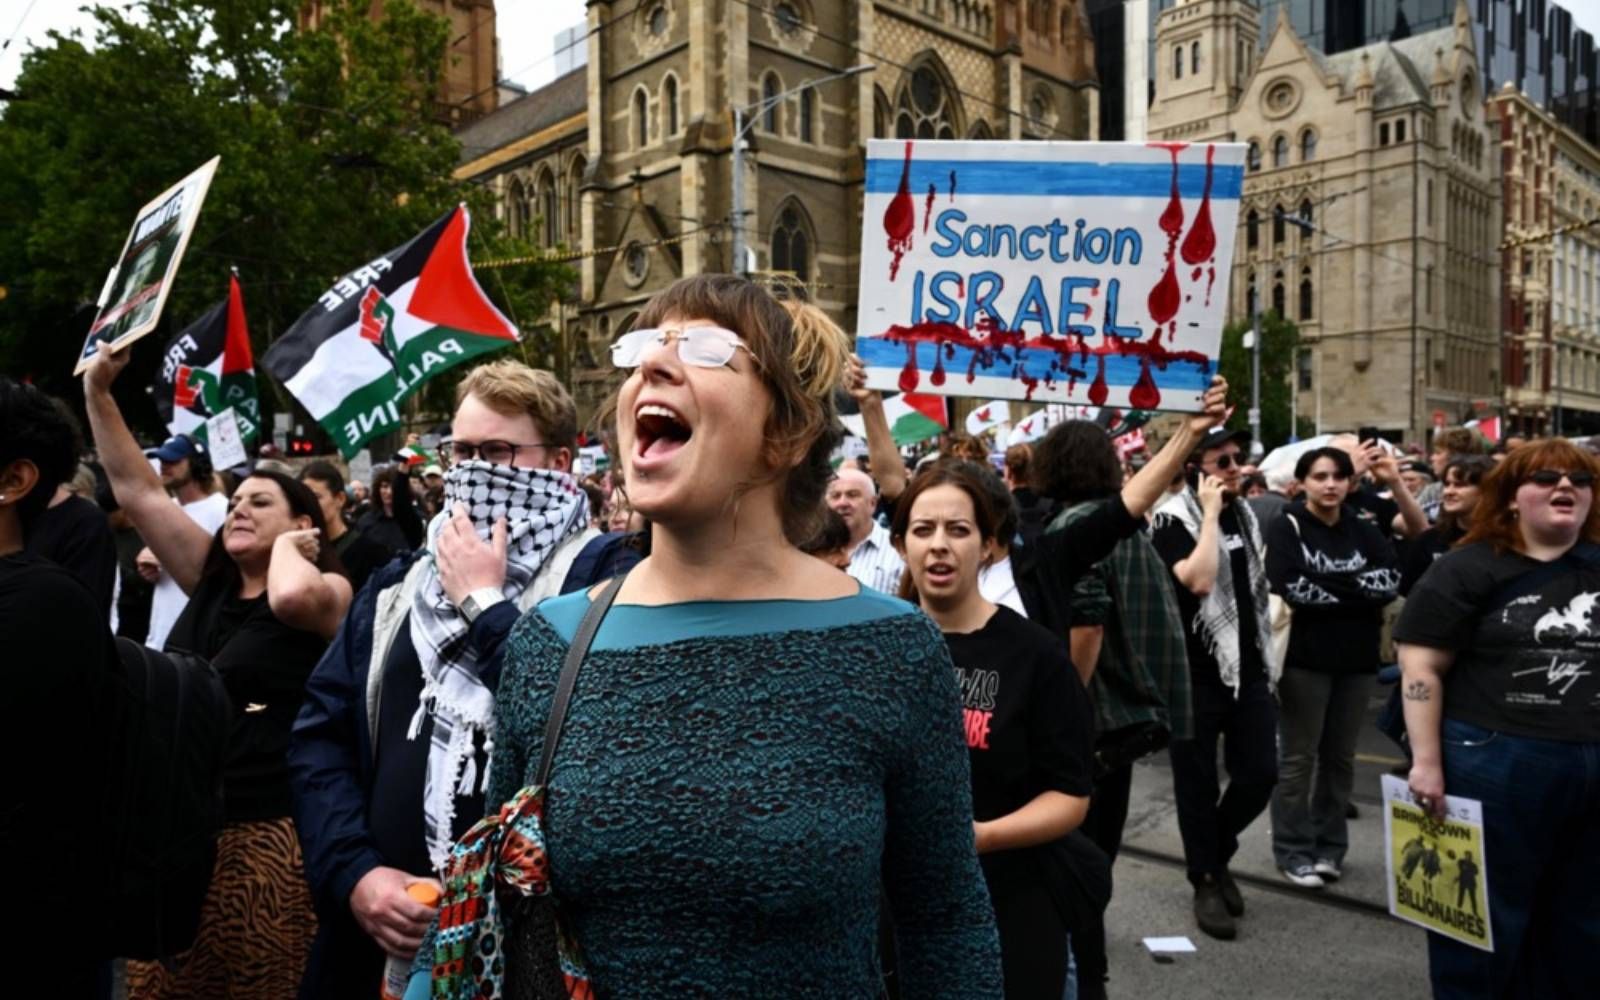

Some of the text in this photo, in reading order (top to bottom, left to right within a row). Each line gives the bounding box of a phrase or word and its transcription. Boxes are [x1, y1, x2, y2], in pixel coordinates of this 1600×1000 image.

[930, 208, 1143, 266] Sanction
[910, 269, 1142, 338] ISRAEL
[1398, 881, 1486, 938] BILLIONAIRES
